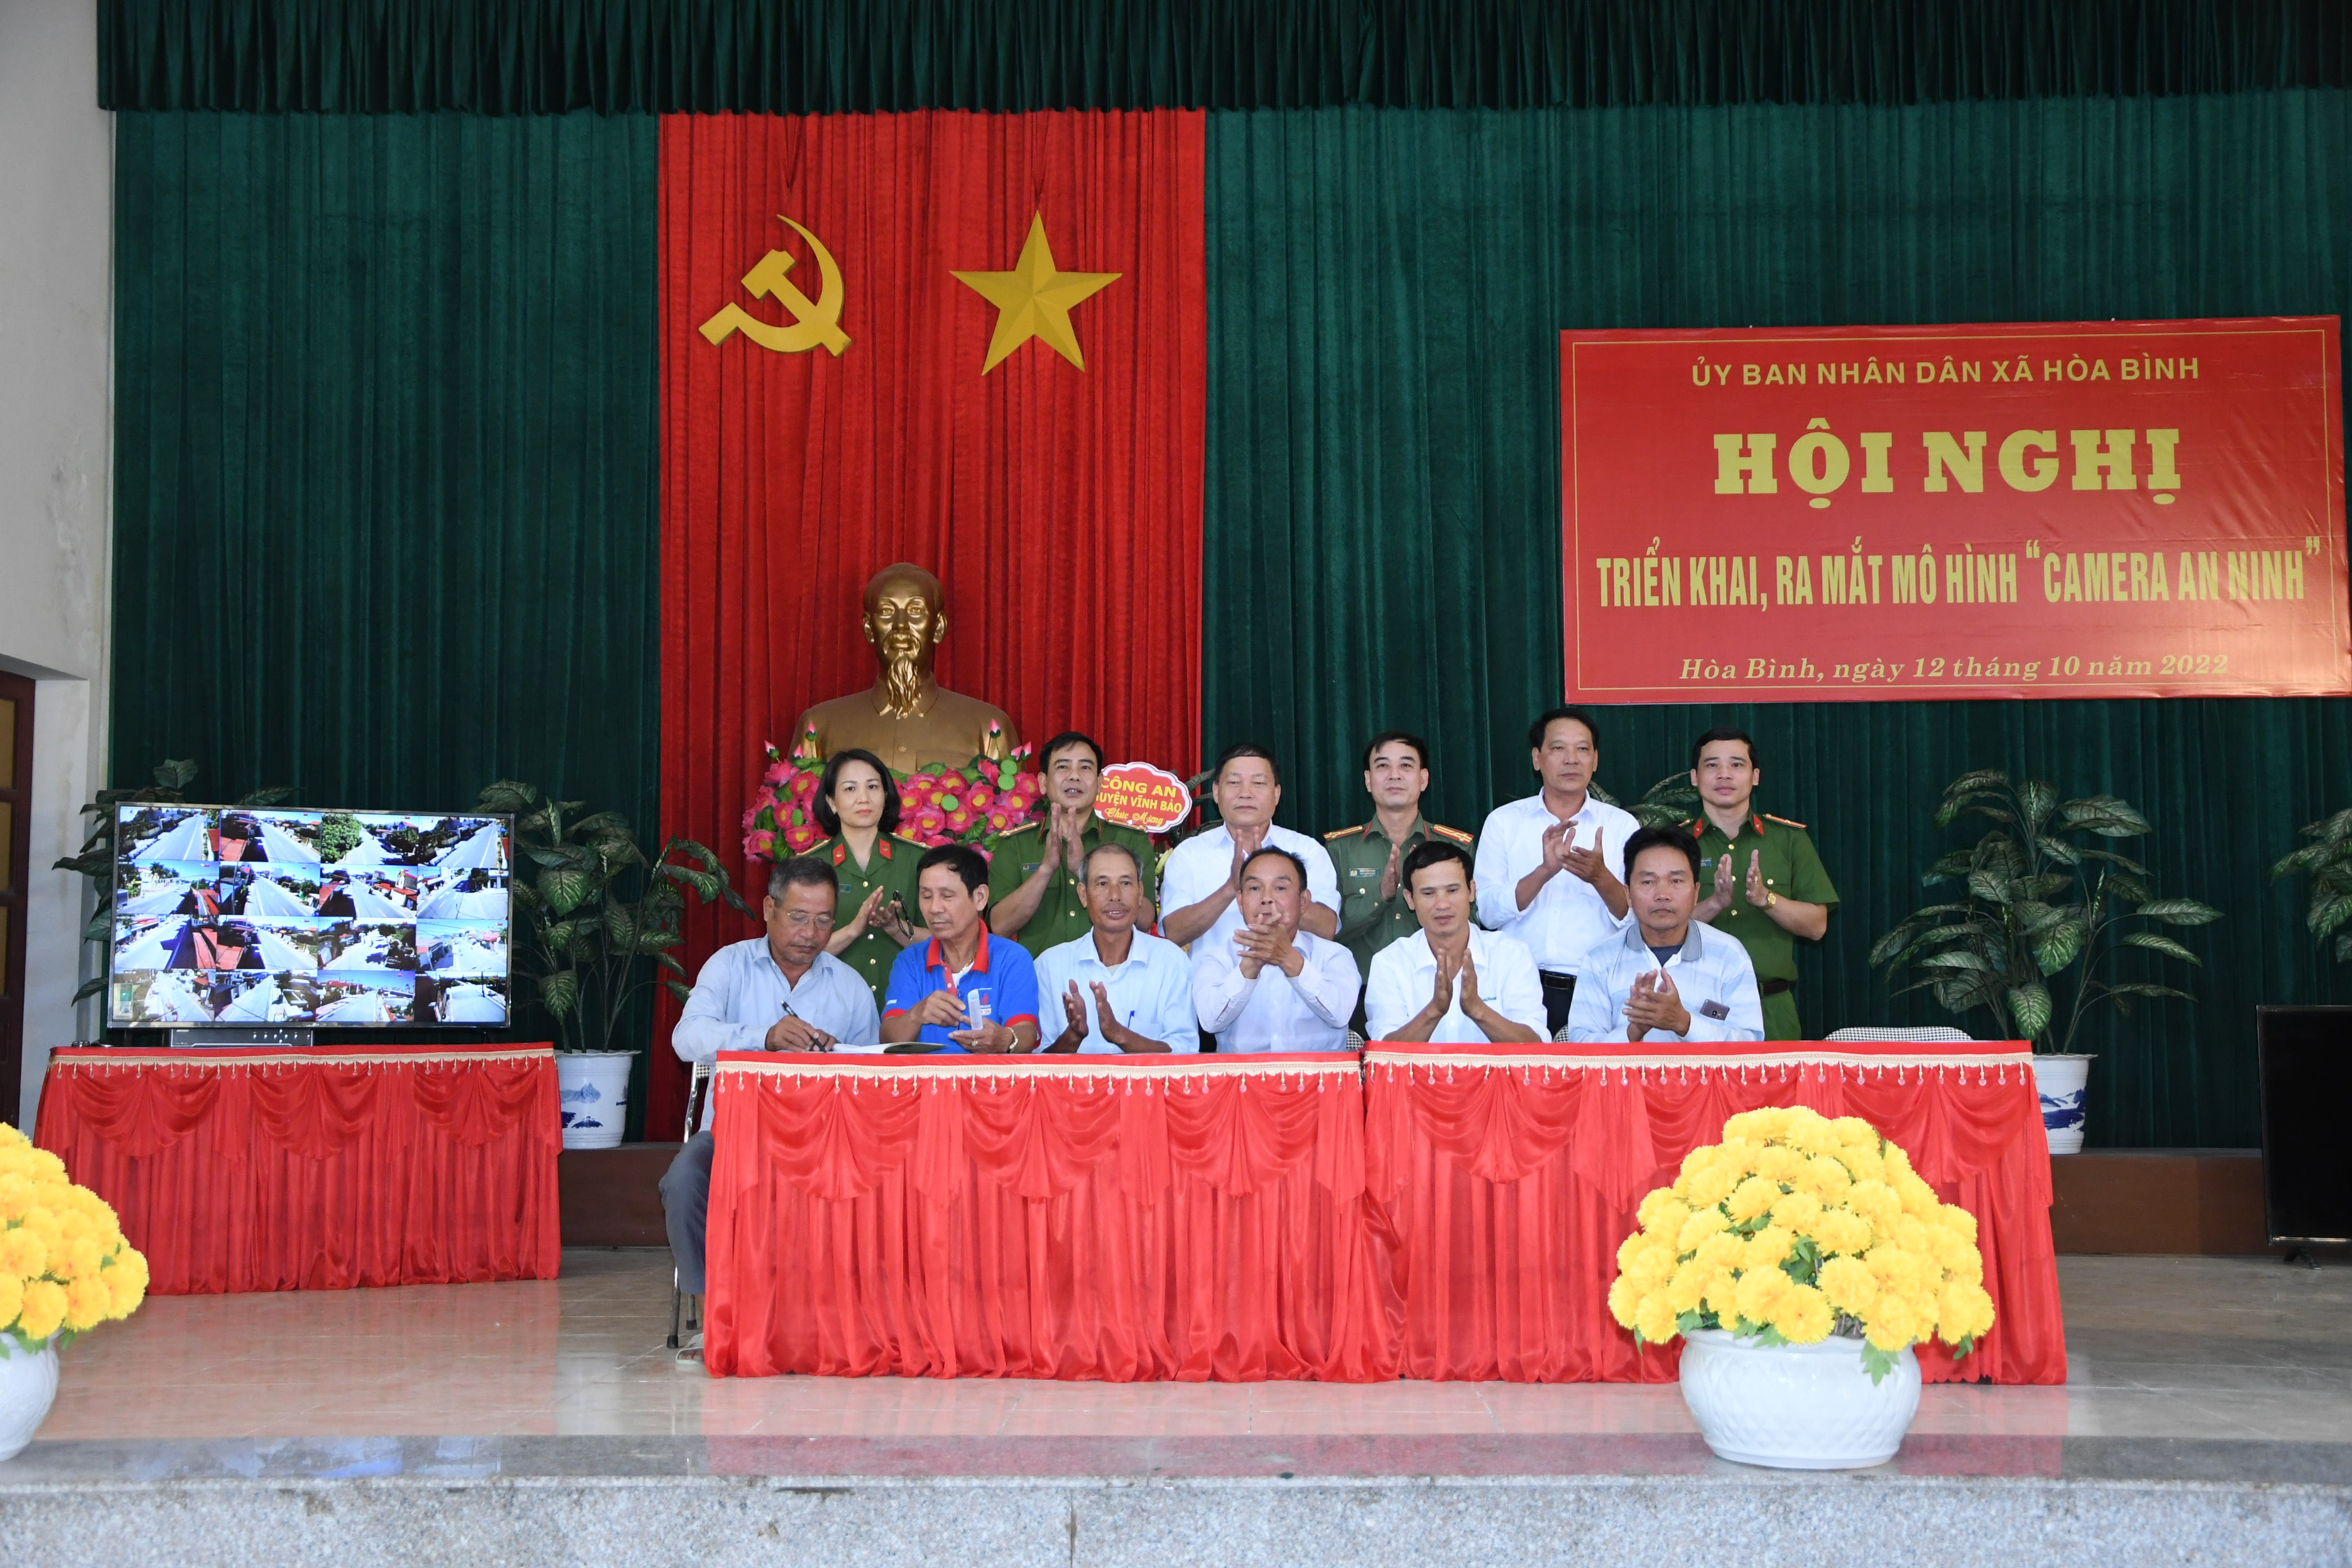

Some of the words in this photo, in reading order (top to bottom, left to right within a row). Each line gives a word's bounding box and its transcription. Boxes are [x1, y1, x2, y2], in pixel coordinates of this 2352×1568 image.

[1692, 355, 1732, 387] ỦY
[1743, 363, 1807, 386] BAN
[1818, 356, 1905, 385] NHÂN
[1917, 355, 1981, 384] DÂN
[1992, 355, 2034, 382] XÃ
[2043, 353, 2111, 381] HÒA
[2121, 352, 2199, 381] BÌNH
[1713, 417, 1894, 509] HỘI
[1923, 429, 2181, 505] NGHỊ
[1596, 536, 1681, 607] TRIỂN
[1690, 556, 1767, 612] KHAI,
[1776, 556, 1813, 605] RA
[1821, 536, 1883, 604] MẮT
[1892, 544, 1937, 604] MÔ
[1946, 544, 2017, 603] HÌNH
[2179, 552, 2219, 600] AN
[1680, 658, 1736, 679] Hòa
[1745, 657, 1824, 682] Bình,
[1833, 657, 1905, 683] ngày
[1913, 657, 1945, 678] 12
[1953, 656, 2041, 681] tháng
[2049, 656, 2081, 676] 10
[2088, 656, 2152, 676] năm
[2160, 654, 2229, 675] 2022
[1101, 775, 1147, 793] CÔNG
[1152, 785, 1177, 798] AN
[1104, 807, 1129, 819] Chúc
[1130, 795, 1157, 809] VĨNH
[1160, 798, 1182, 813] BẢO
